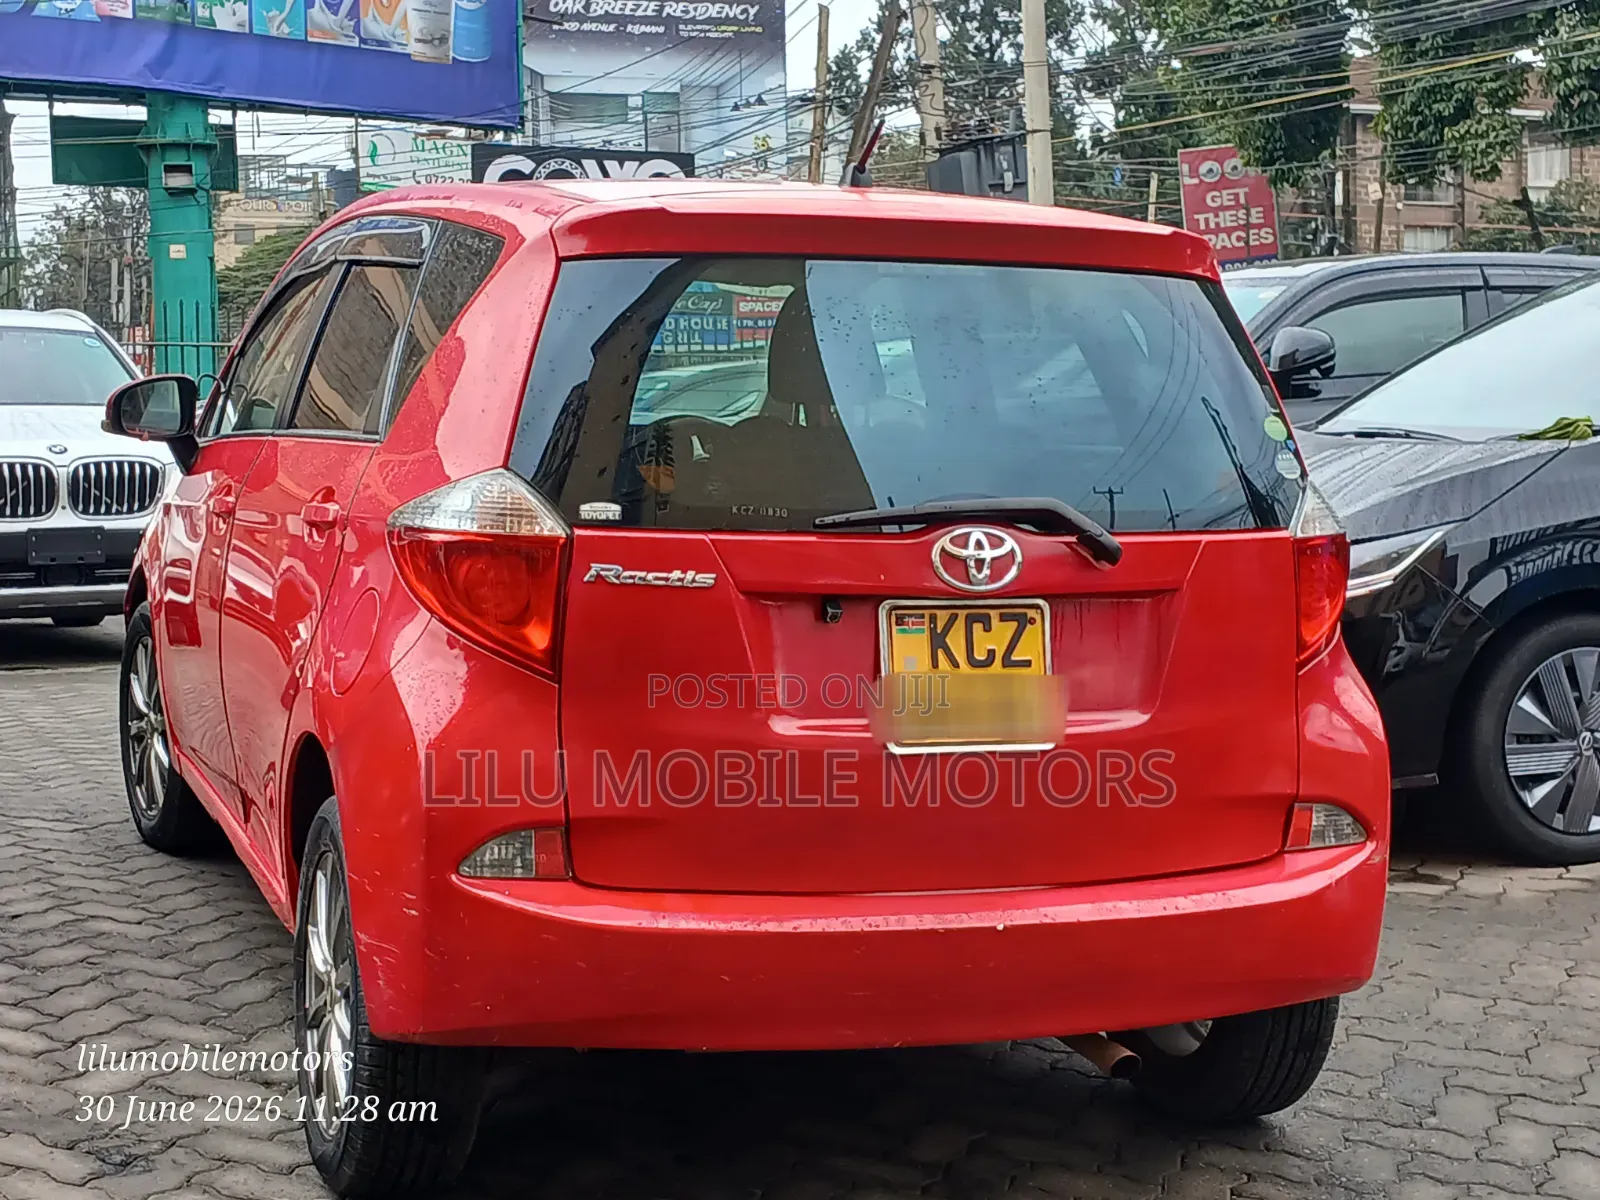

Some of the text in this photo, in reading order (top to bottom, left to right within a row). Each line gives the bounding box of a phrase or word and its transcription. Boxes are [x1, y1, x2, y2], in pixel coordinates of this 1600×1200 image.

[587, 0, 661, 16] BREEZE
[661, 1, 760, 25] RESIDENCY
[580, 20, 618, 32] AVENUE
[1206, 187, 1249, 207] GET
[1194, 207, 1264, 230] THESE
[1203, 227, 1274, 250] PACES
[579, 511, 621, 520] TOYOPET
[732, 505, 754, 516] KCZ
[583, 563, 717, 588] Ractis
[929, 613, 1032, 669] KCZ
